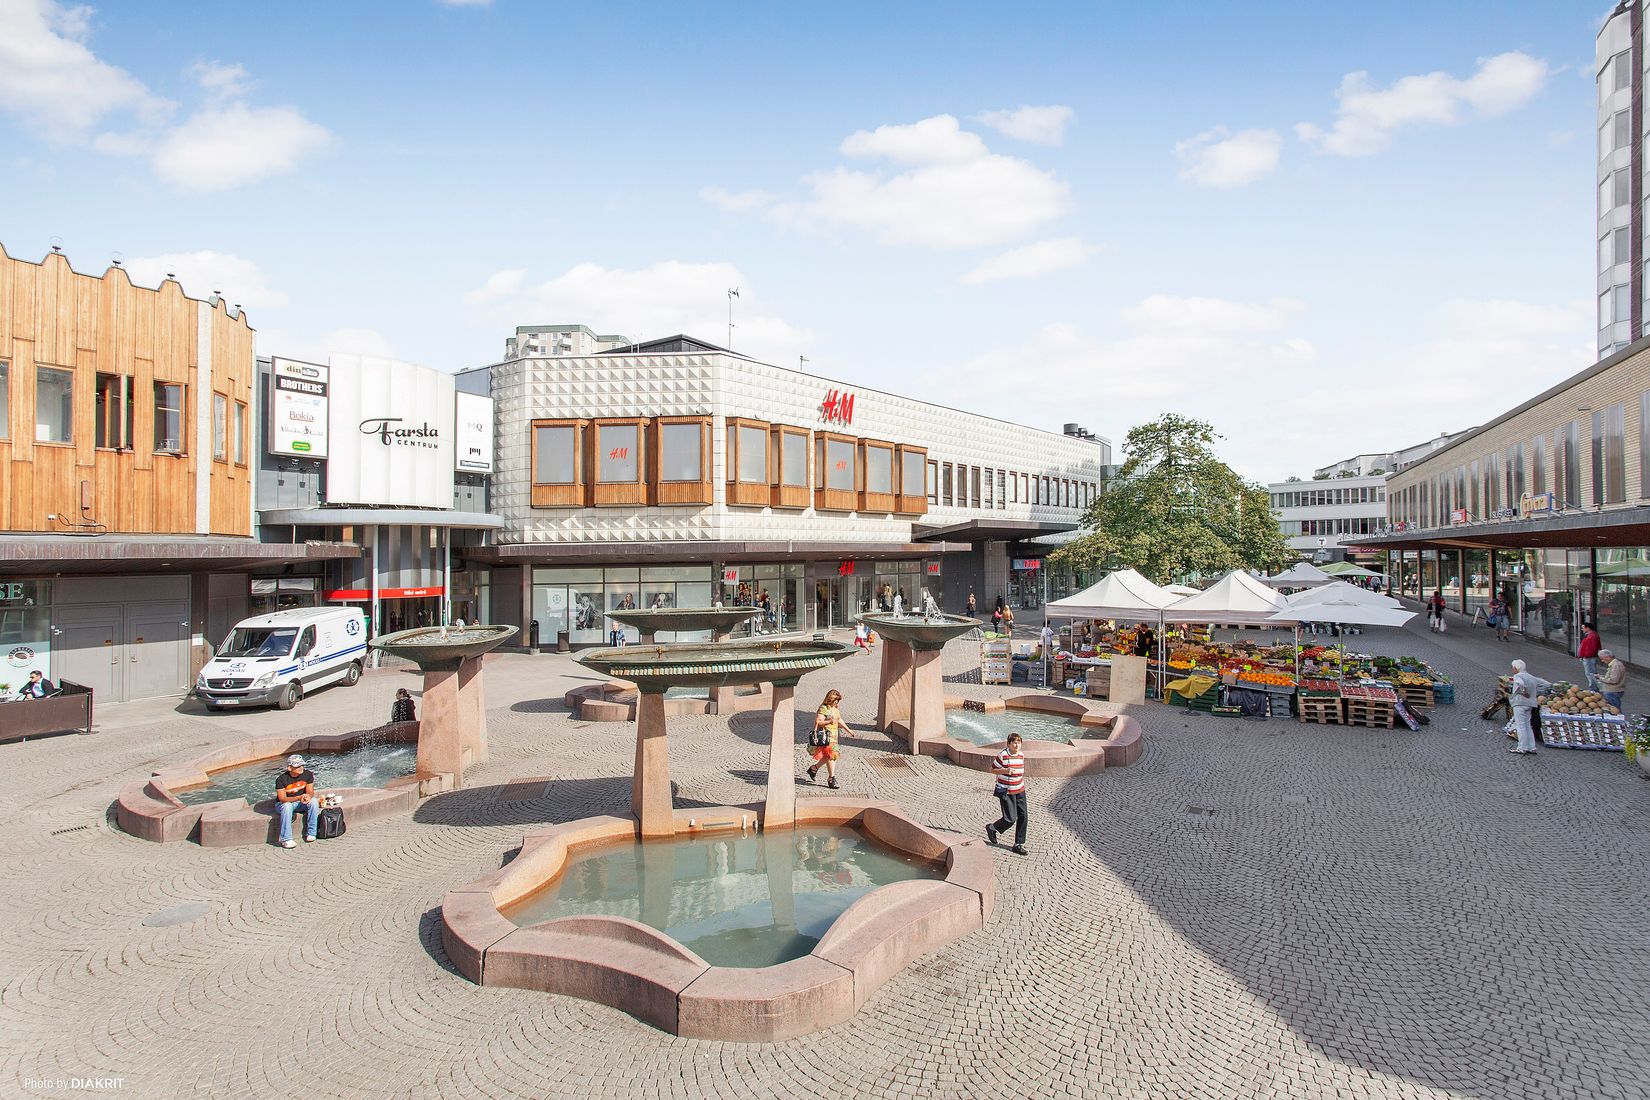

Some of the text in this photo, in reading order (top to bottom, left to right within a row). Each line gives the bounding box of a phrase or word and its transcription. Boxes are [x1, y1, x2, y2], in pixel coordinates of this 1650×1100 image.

[280, 378, 322, 394] BROTHERS
[821, 389, 855, 425] H&M
[359, 417, 439, 446] Farsta
[397, 439, 438, 450] CENTRUM
[609, 447, 628, 460] H&M
[725, 570, 737, 581] H&M
[839, 560, 855, 577] H&M
